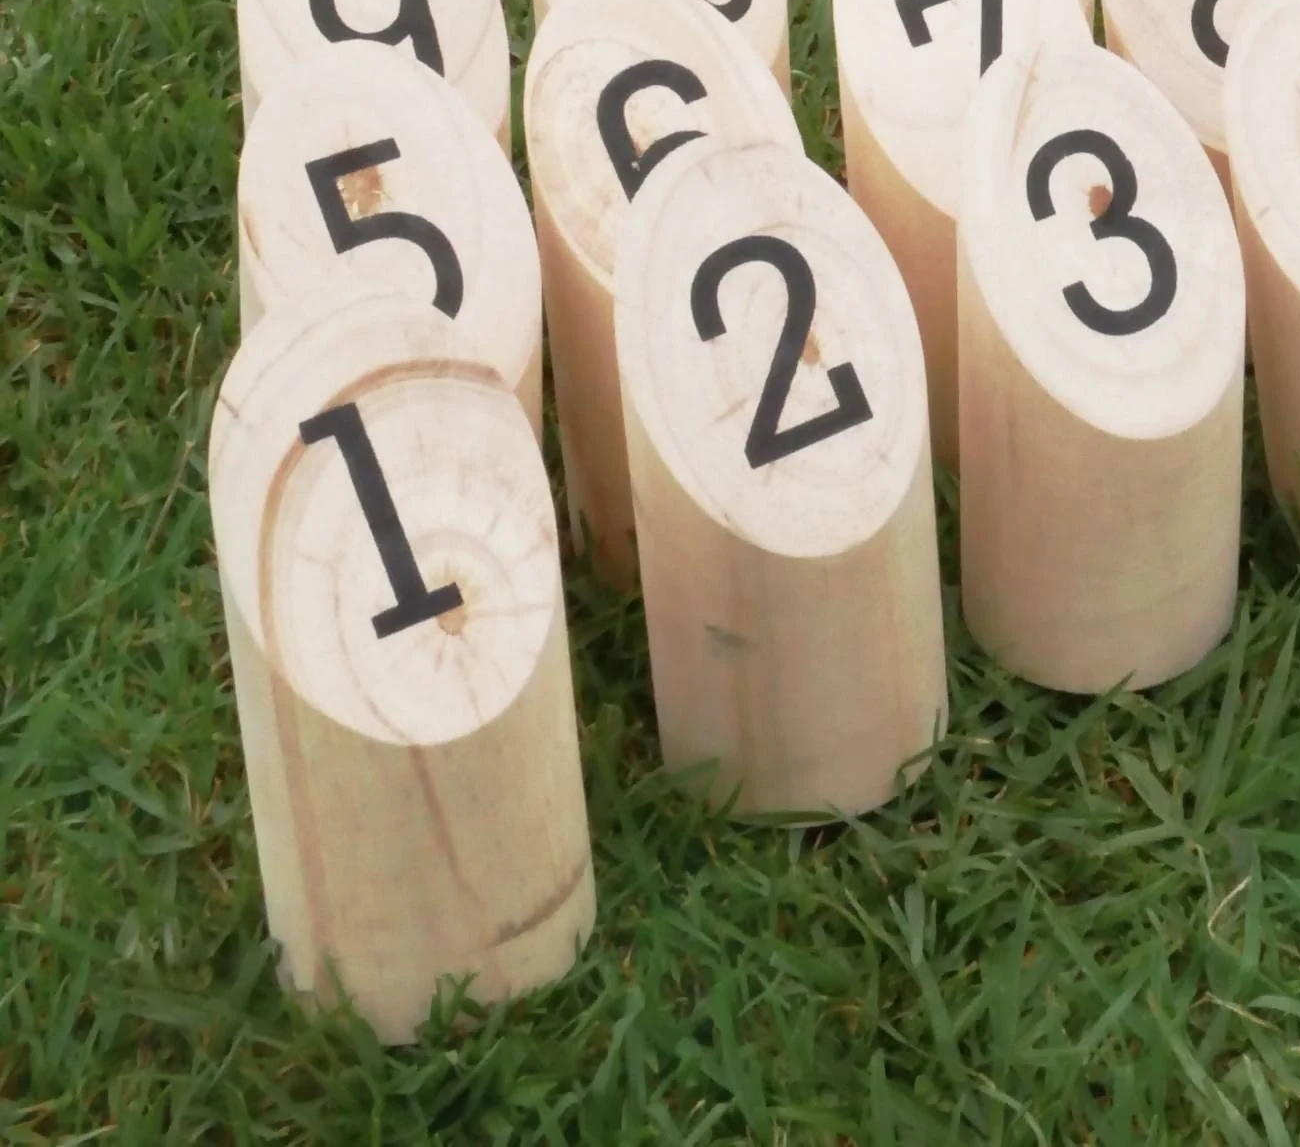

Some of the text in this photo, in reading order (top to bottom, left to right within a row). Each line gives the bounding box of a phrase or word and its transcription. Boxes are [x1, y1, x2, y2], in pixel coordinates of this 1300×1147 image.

[305, 138, 464, 319] 5
[1026, 129, 1178, 336] 3
[690, 234, 873, 469] 2
[298, 402, 465, 639] 1
